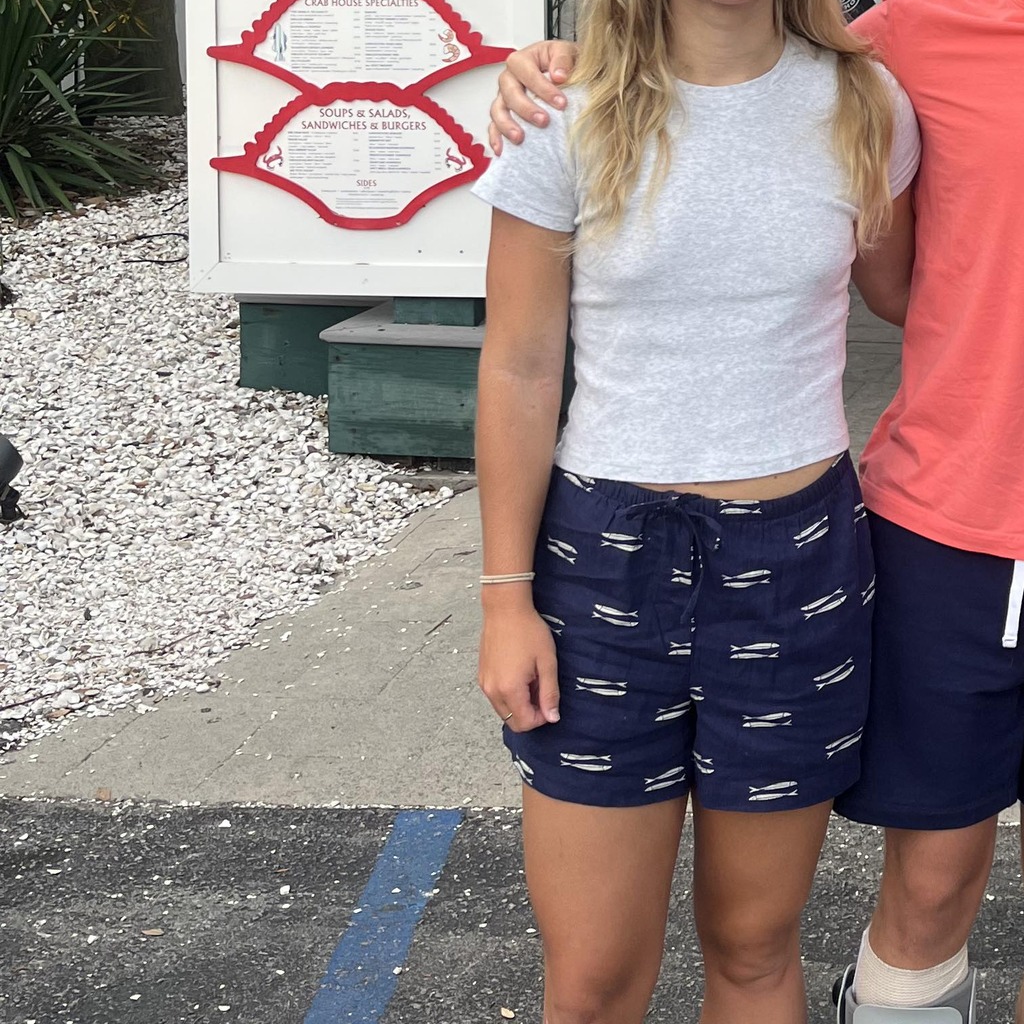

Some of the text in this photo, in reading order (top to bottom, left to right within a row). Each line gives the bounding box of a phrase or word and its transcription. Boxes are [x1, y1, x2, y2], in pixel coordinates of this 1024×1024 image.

[319, 108, 411, 119] SOUPS & SALADS,
[301, 120, 427, 131] SANDWICHES & BURGERS
[356, 179, 377, 187] SIDES
